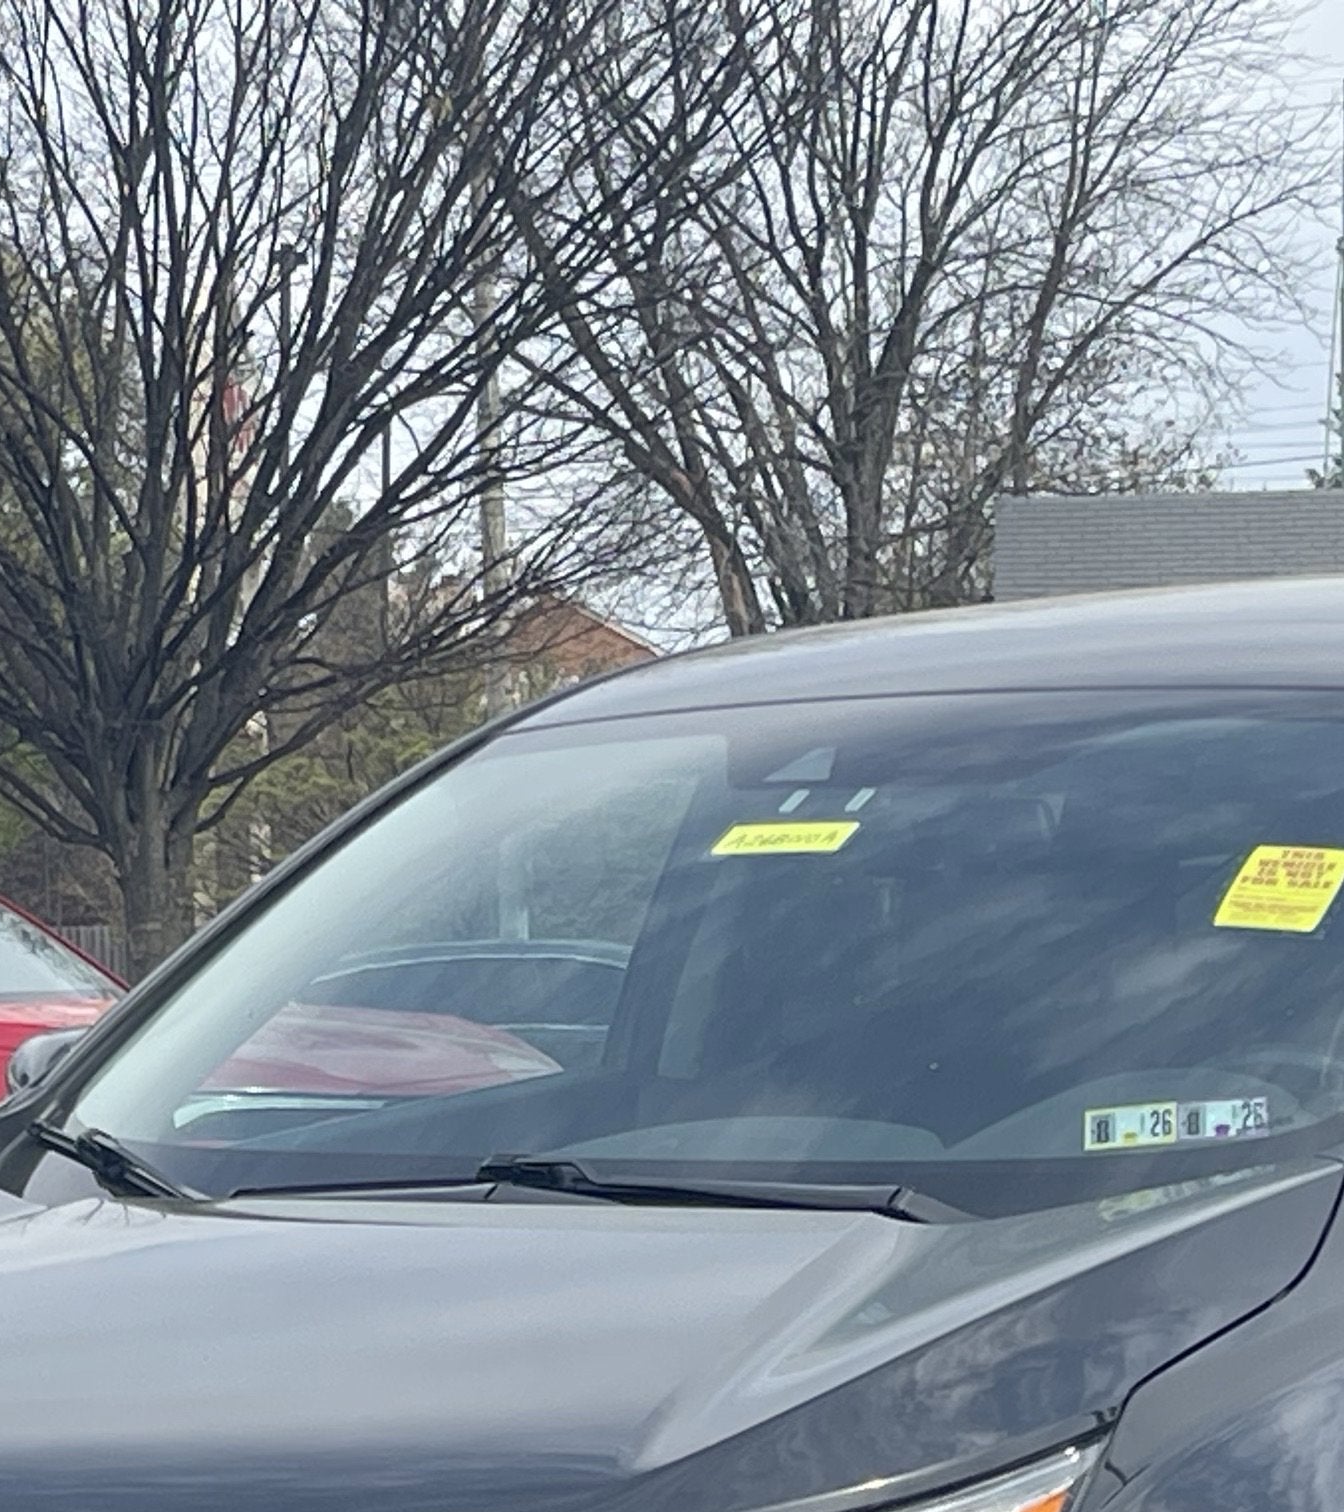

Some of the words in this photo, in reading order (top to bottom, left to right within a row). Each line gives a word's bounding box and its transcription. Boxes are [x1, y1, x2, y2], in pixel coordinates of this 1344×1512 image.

[1281, 850, 1325, 859] THIS
[1285, 869, 1325, 879] NOT
[1241, 876, 1279, 886] FOR
[1287, 880, 1333, 889] SALE
[1150, 1109, 1172, 1137] 26
